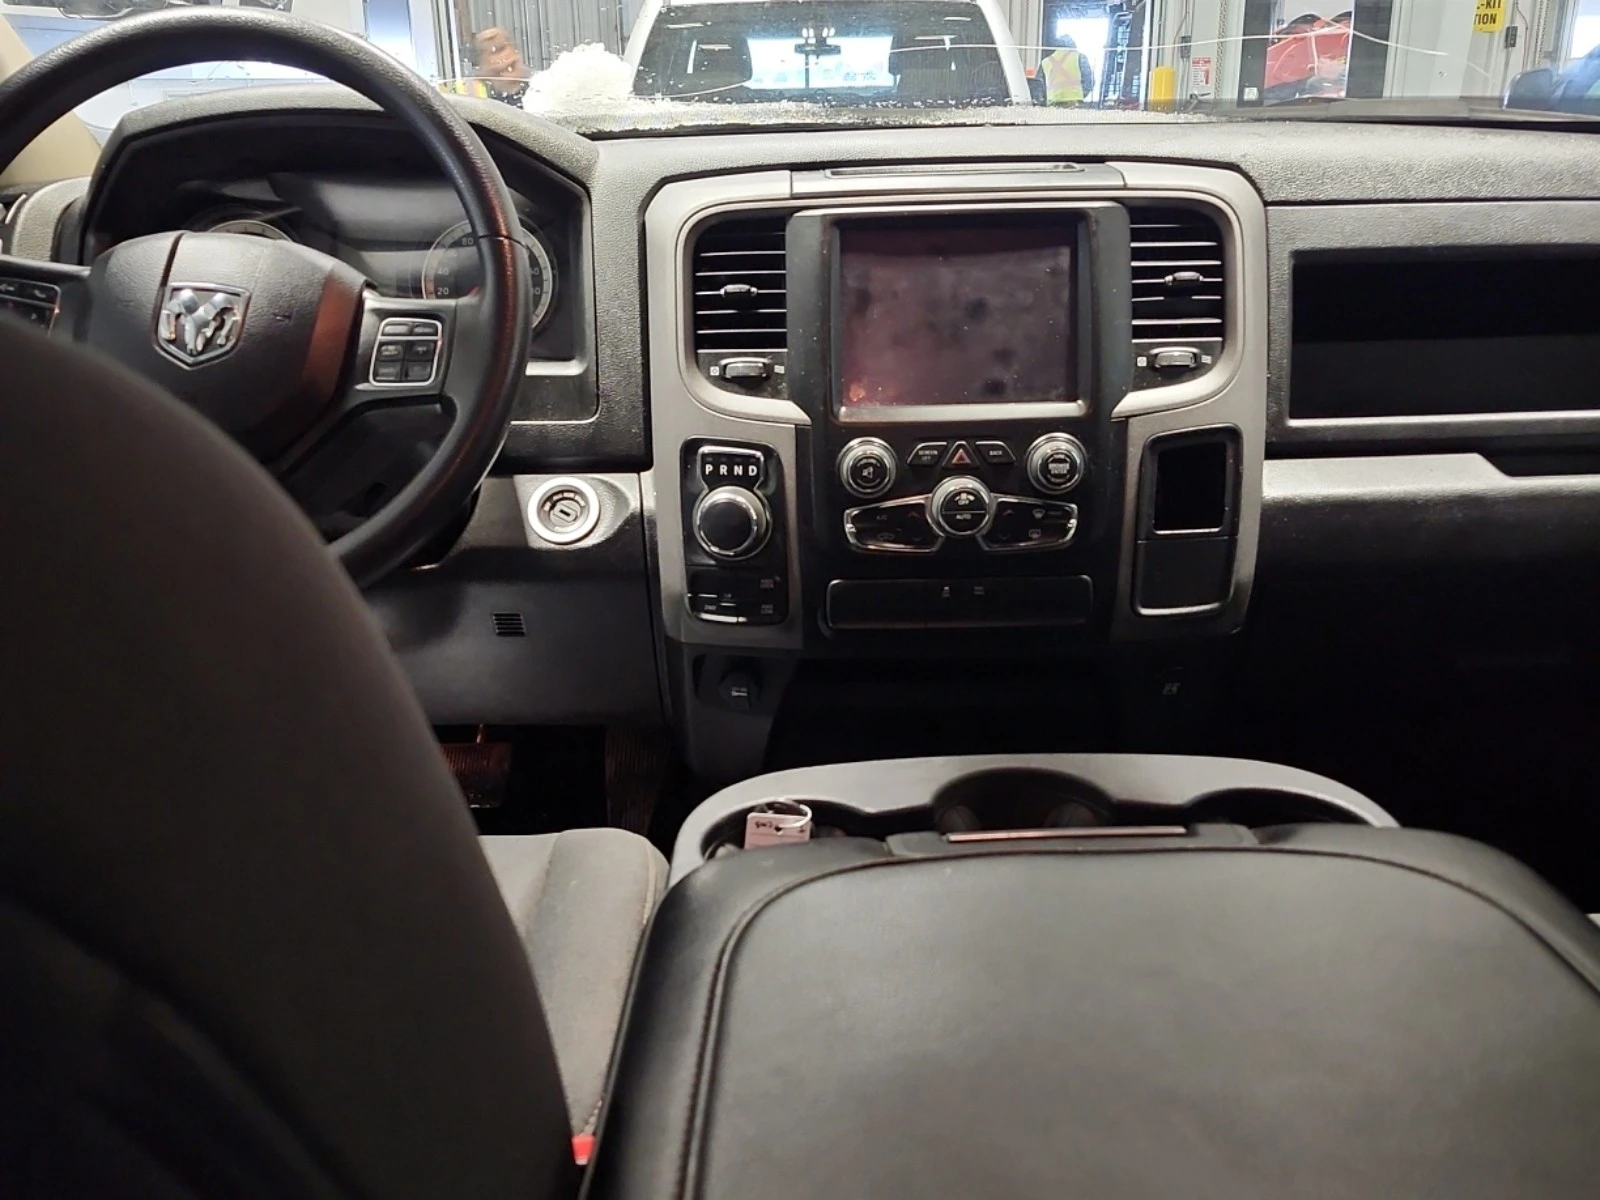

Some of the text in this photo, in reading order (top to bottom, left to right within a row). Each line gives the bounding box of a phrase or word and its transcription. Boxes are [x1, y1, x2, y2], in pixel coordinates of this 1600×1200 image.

[437, 287, 449, 295] 20
[705, 463, 758, 477] P R N D
